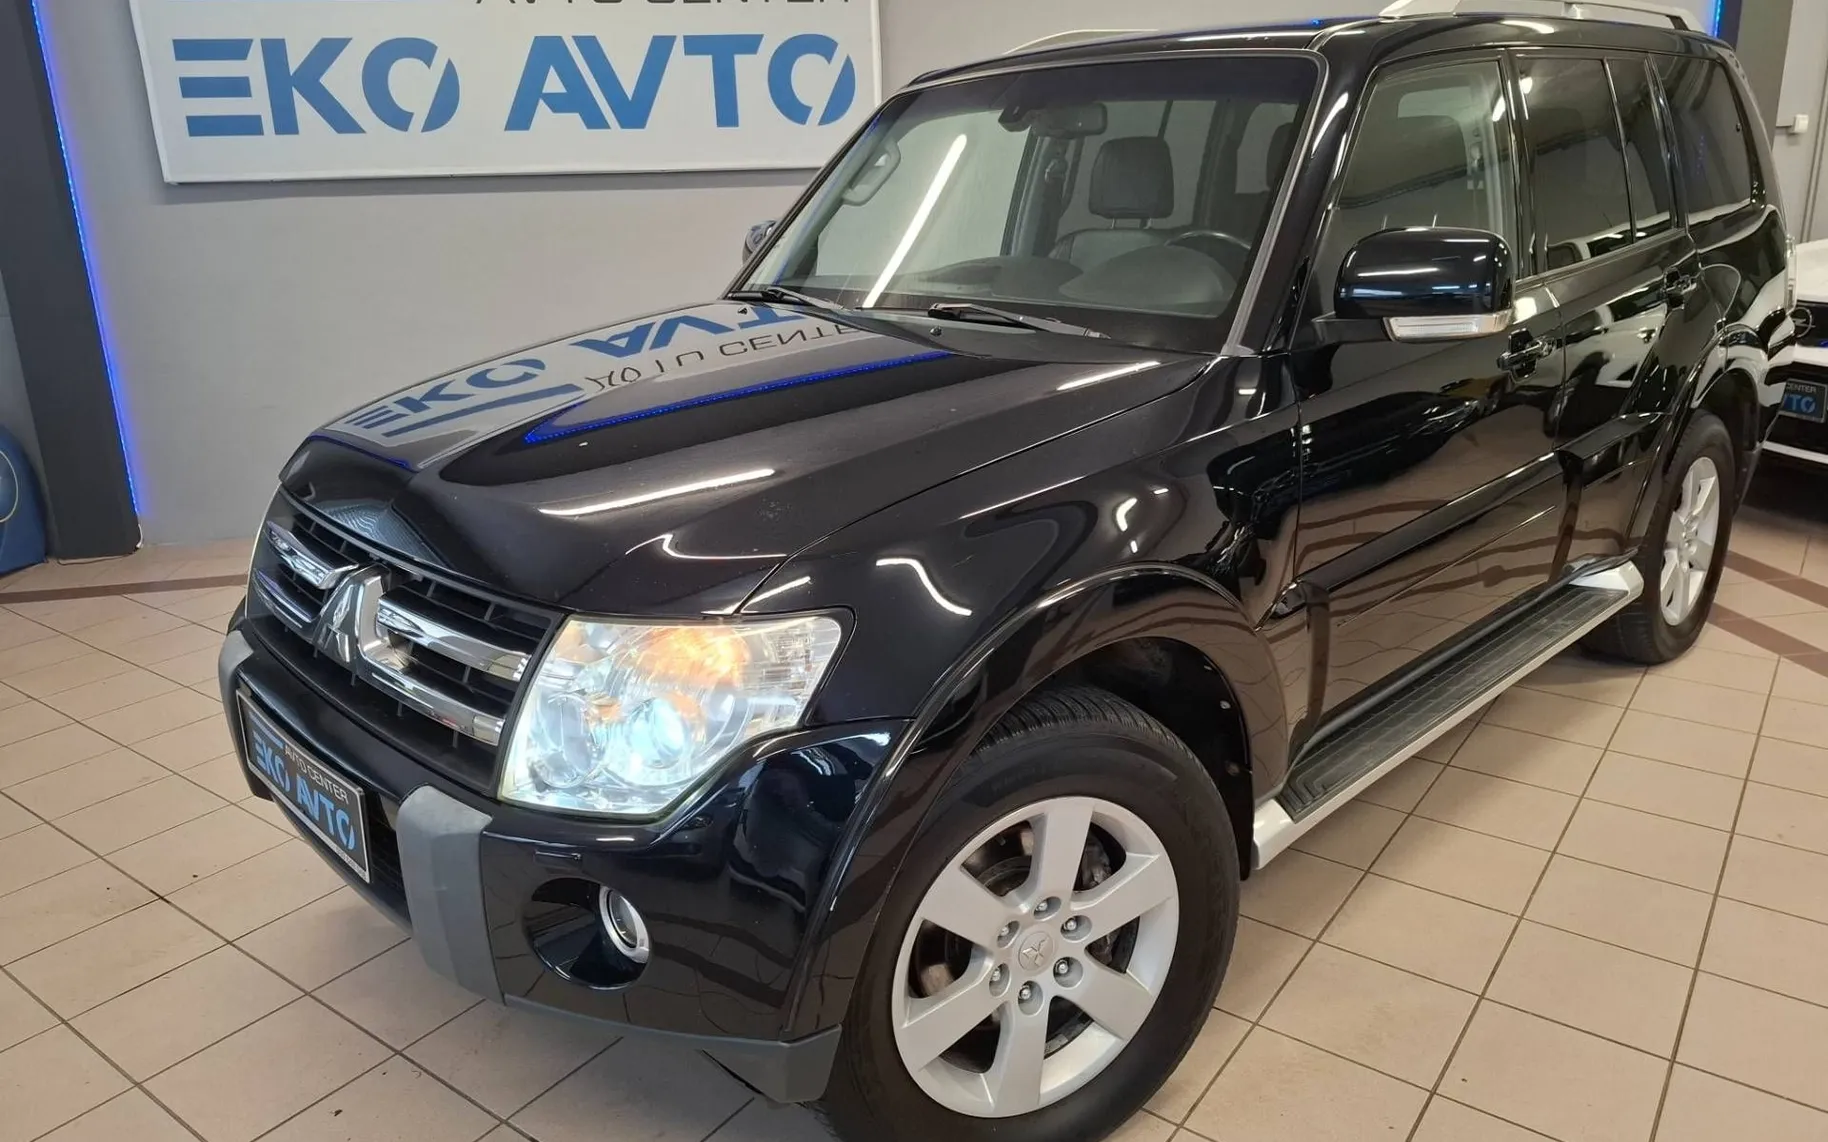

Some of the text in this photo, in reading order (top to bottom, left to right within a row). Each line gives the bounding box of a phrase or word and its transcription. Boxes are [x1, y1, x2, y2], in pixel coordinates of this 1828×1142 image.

[171, 32, 858, 137] EKO AVTO
[253, 731, 356, 850] EKO AVTO
[284, 744, 349, 804] AVTO CENTER
